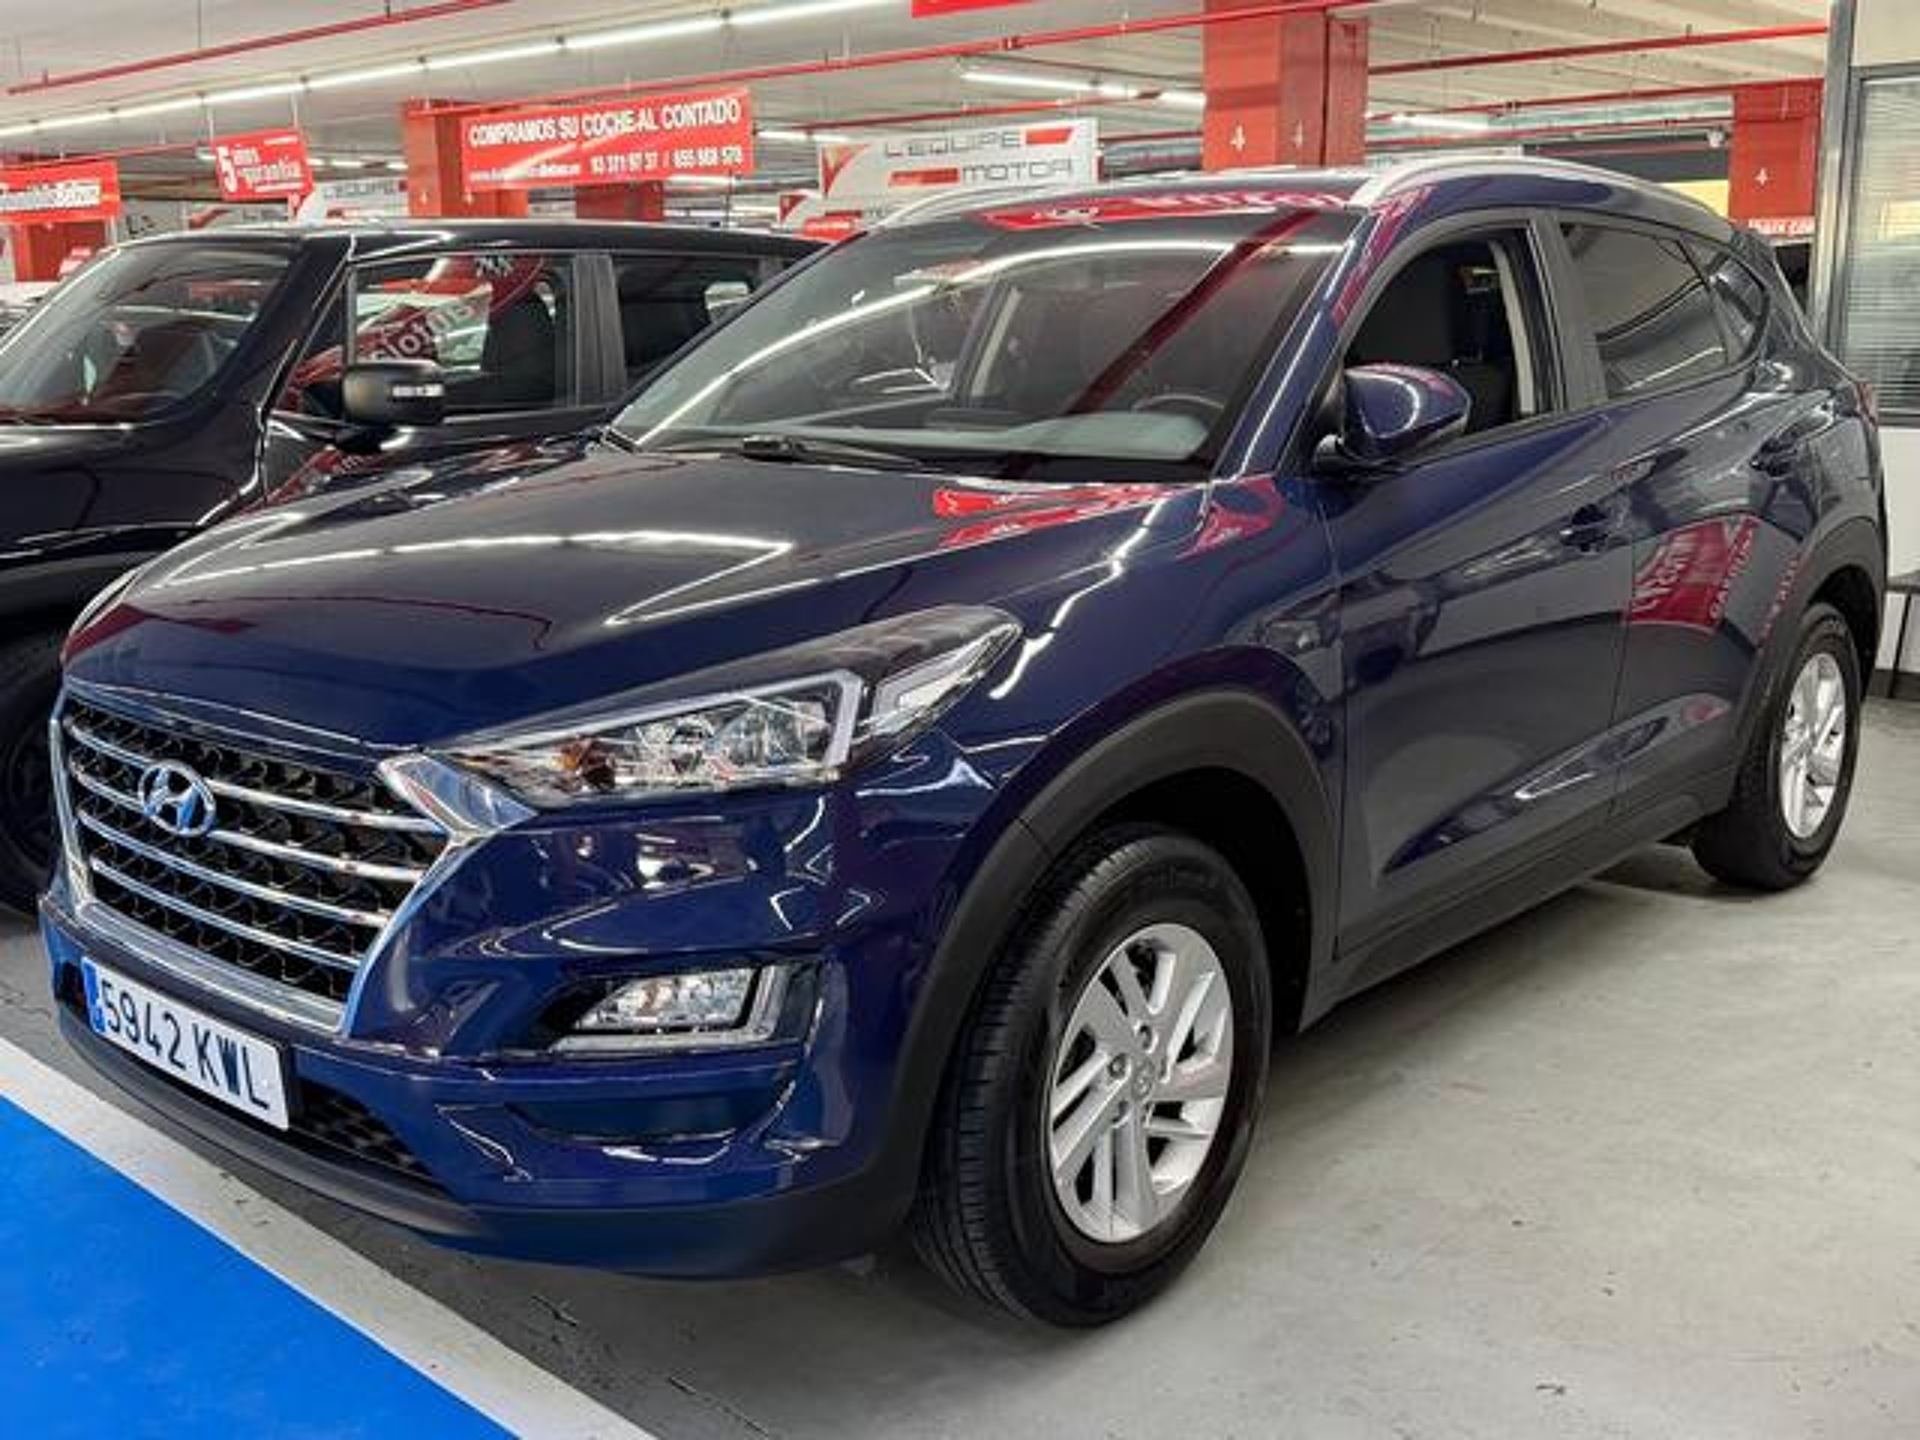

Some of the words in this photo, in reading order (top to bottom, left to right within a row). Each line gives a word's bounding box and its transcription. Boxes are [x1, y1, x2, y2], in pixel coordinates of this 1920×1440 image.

[469, 118, 557, 147] COMPRAMOS
[559, 115, 580, 139] SU
[581, 108, 635, 137] COCHE
[636, 106, 659, 131] AL
[661, 98, 741, 129] CONTADO
[217, 146, 238, 192] 5
[101, 978, 186, 1071] 5942
[192, 1022, 270, 1111] KWL
